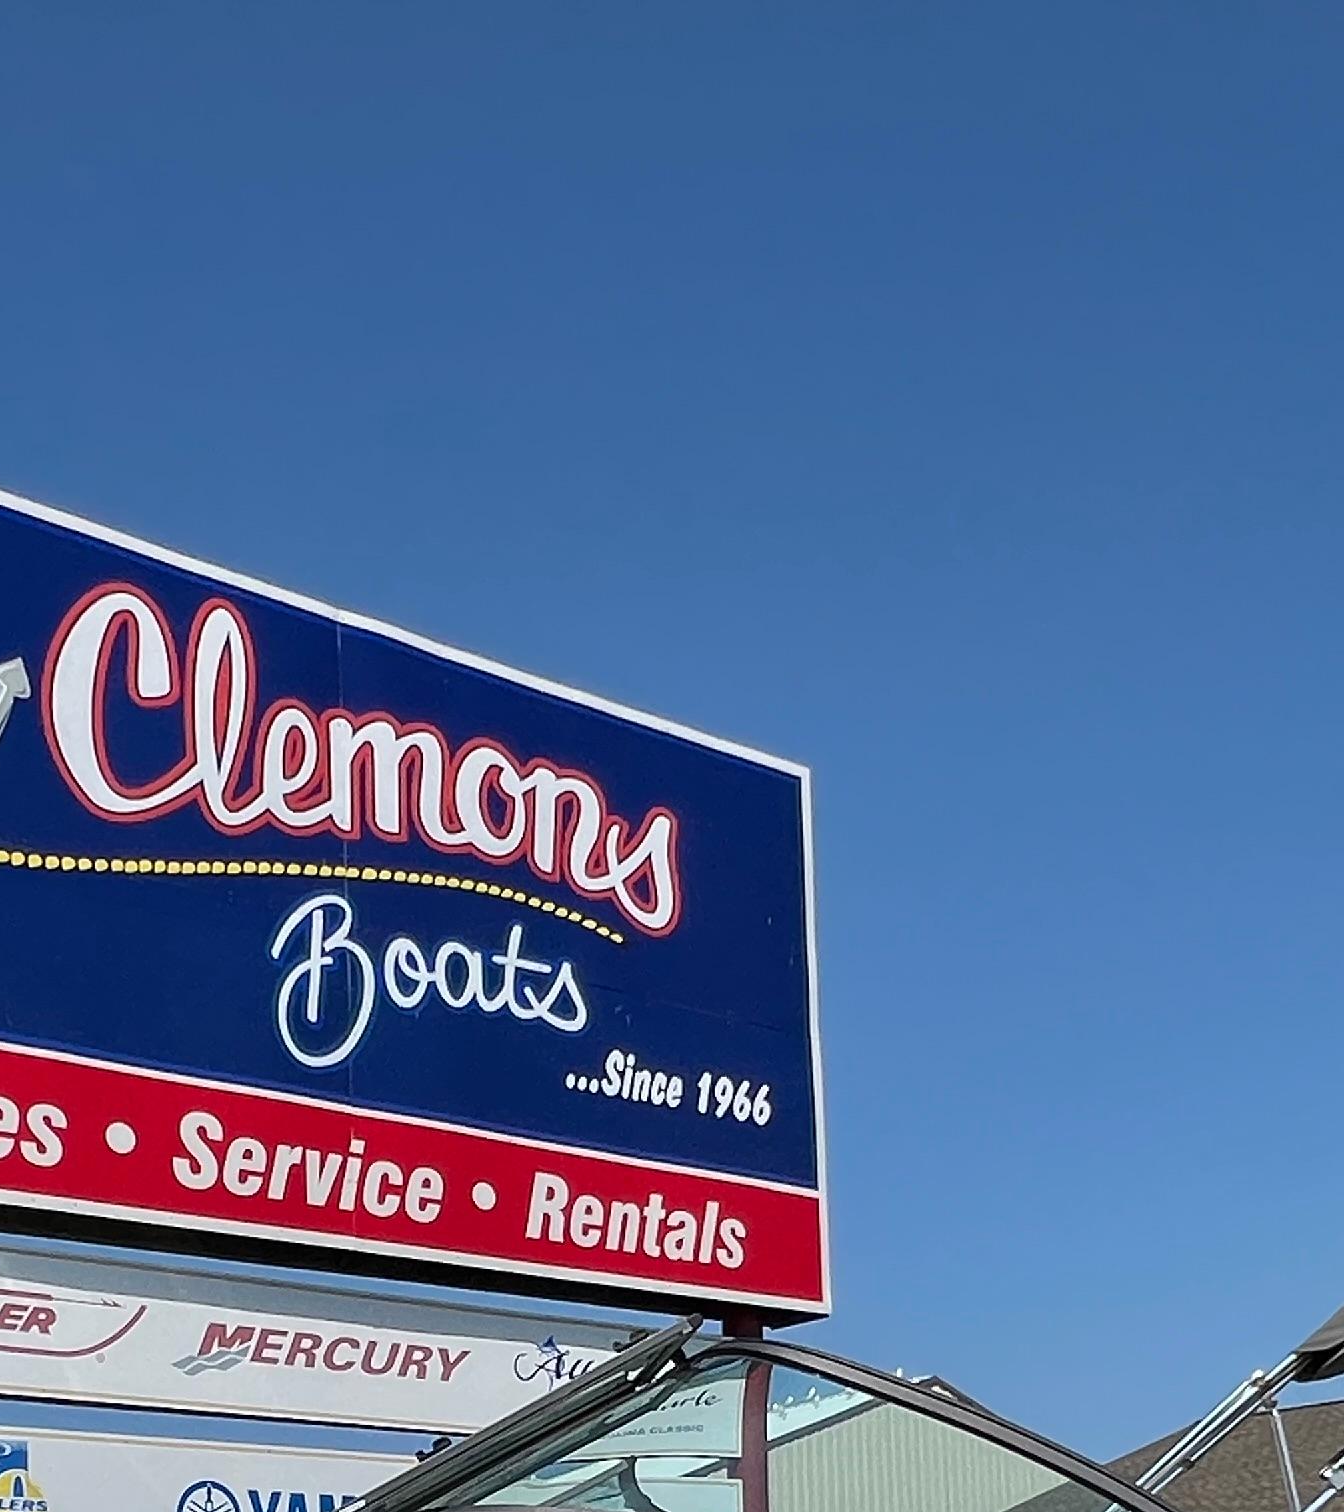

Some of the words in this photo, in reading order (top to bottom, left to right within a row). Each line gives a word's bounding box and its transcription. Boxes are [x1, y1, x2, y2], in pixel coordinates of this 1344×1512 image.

[47, 586, 676, 934] Clemons
[270, 894, 590, 1069] Boats
[696, 1071, 774, 1128] 1966
[171, 1110, 445, 1225] Service
[524, 1172, 748, 1270] Rentals
[197, 1321, 472, 1383] MERCURY
